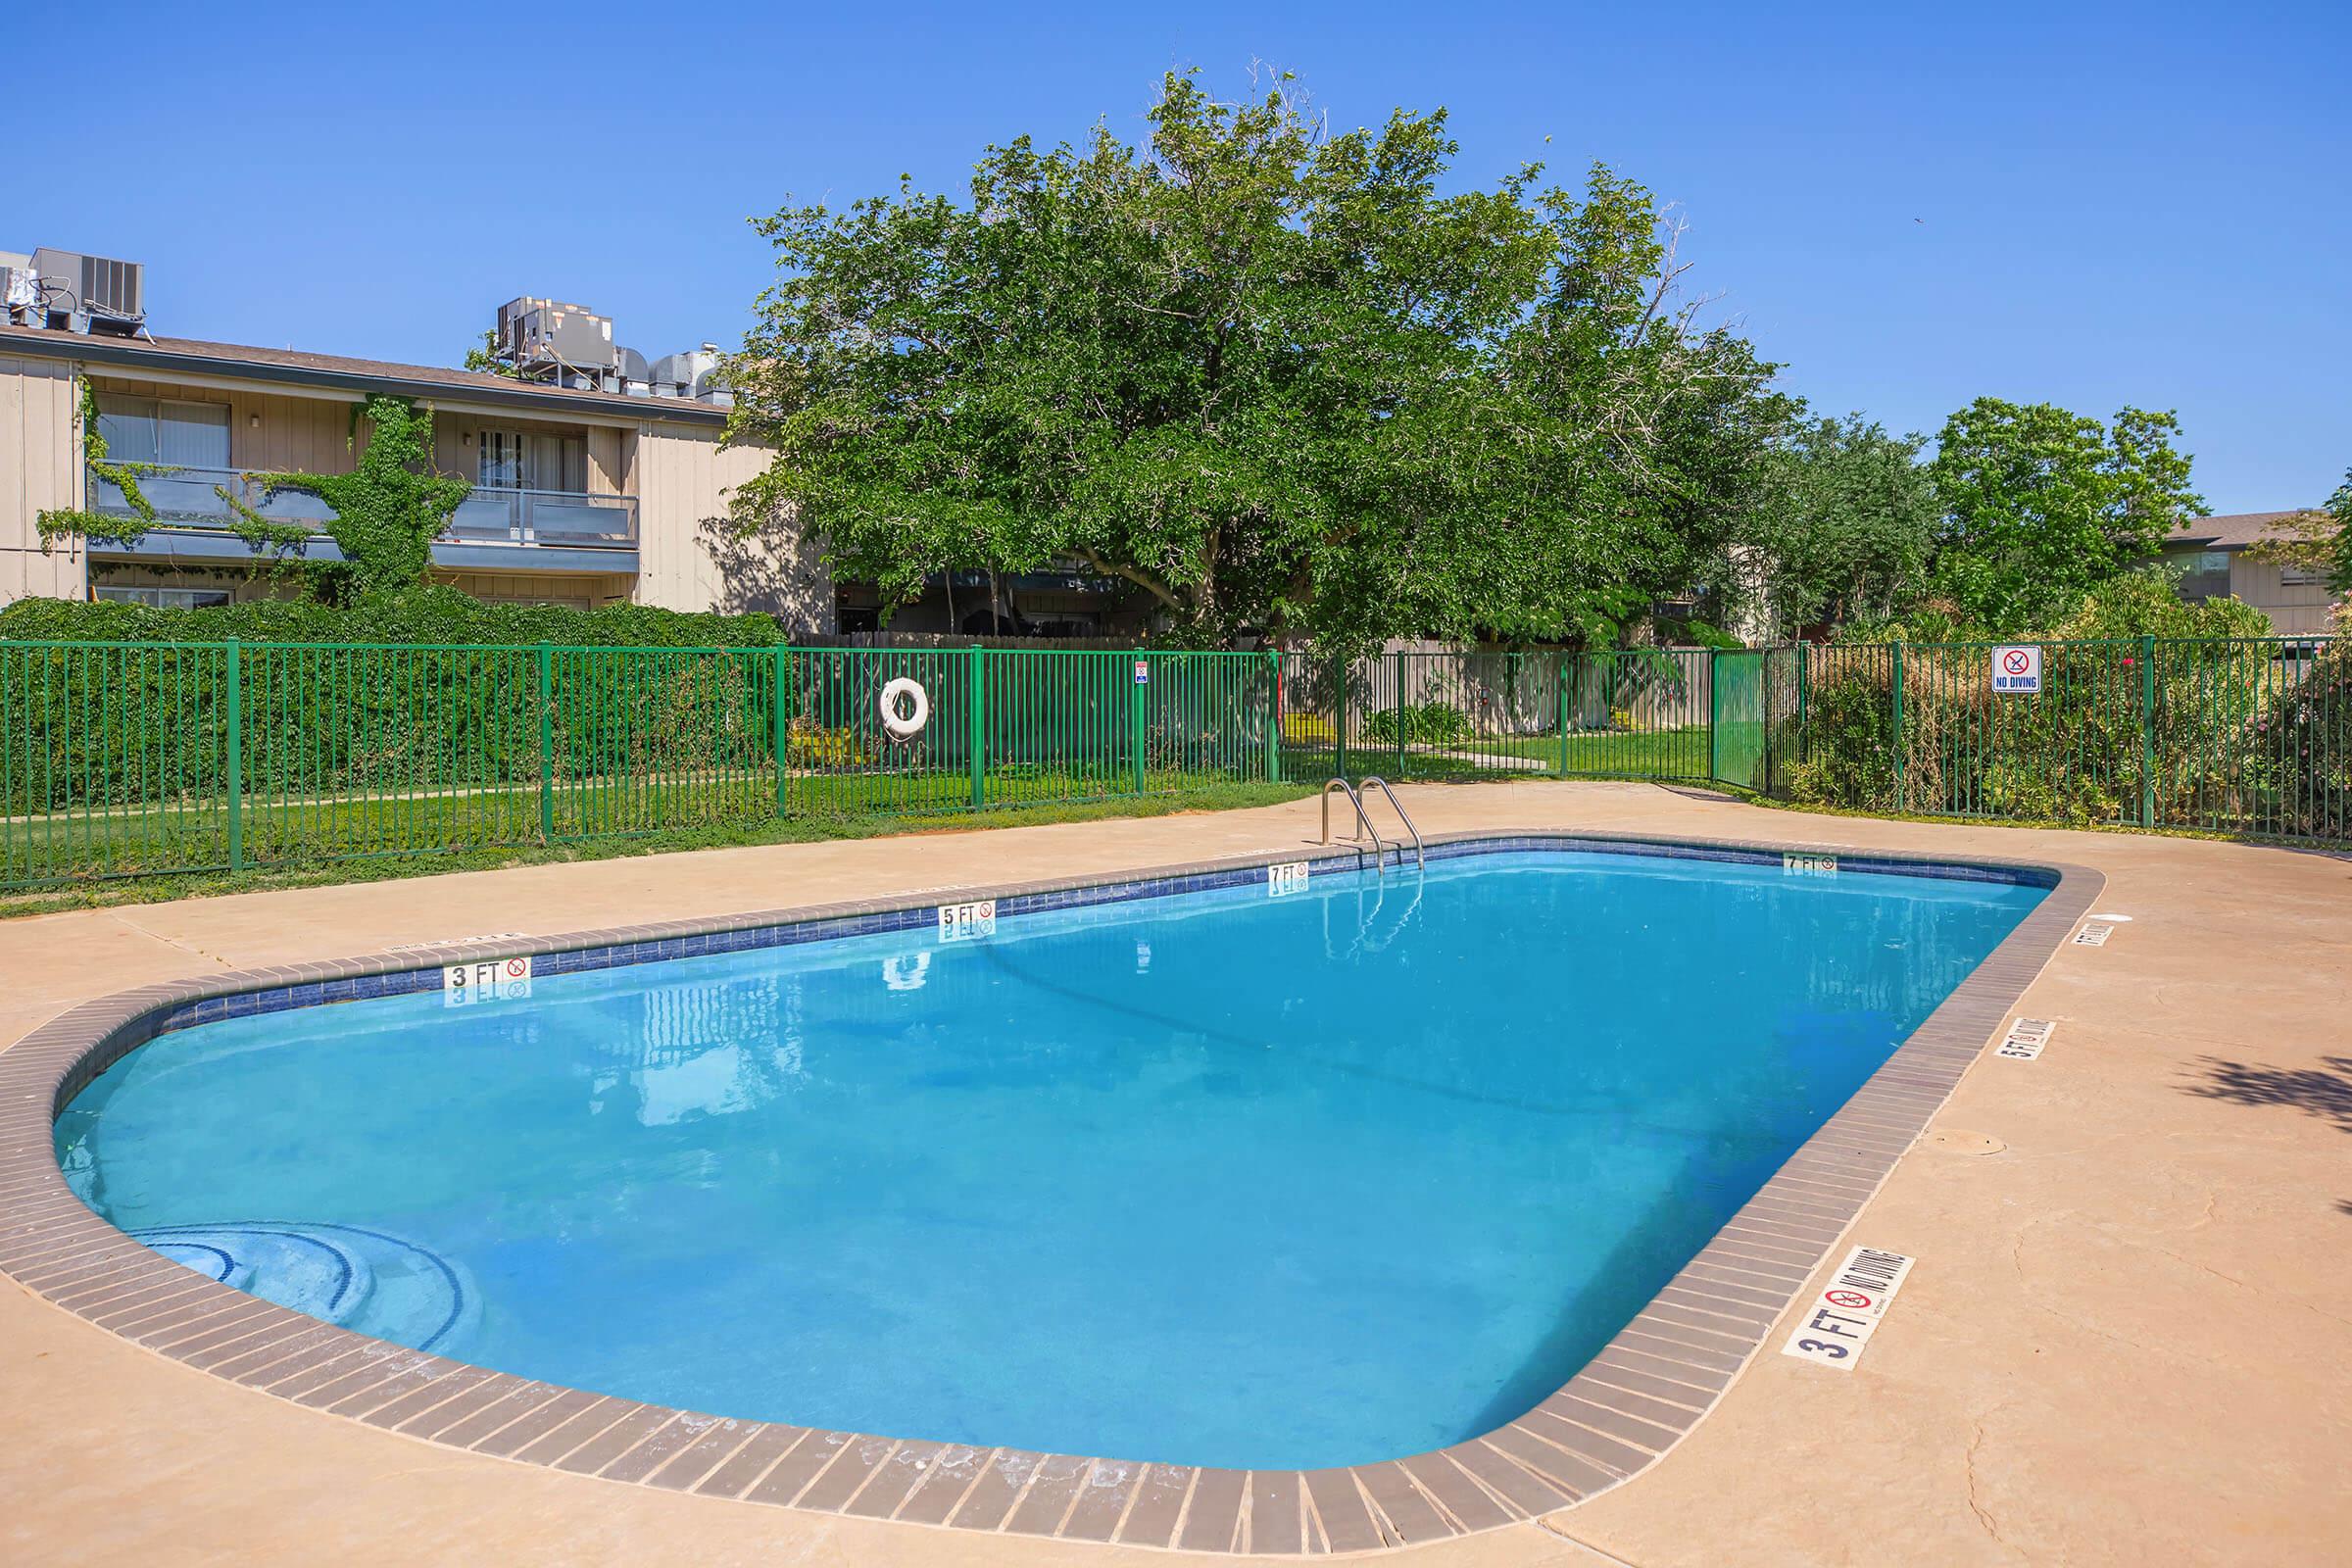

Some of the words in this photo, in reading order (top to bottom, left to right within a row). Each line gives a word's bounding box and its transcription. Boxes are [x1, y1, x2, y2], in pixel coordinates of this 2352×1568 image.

[1996, 676, 2007, 688] NO
[2010, 676, 2036, 688] DIVING
[1788, 856, 1796, 868] 7
[1802, 857, 1817, 869] FT
[1272, 866, 1279, 881] 7
[1283, 865, 1294, 880] FT
[944, 908, 954, 924] 5
[959, 906, 974, 924] FT
[453, 966, 466, 987] 3
[476, 962, 500, 984] FT
[2005, 1041, 2038, 1052] FT
[1848, 1249, 1906, 1280] DIVING
[1838, 1274, 1889, 1294] NO
[1809, 1308, 1867, 1339] FT
[1797, 1339, 1849, 1359] 3
